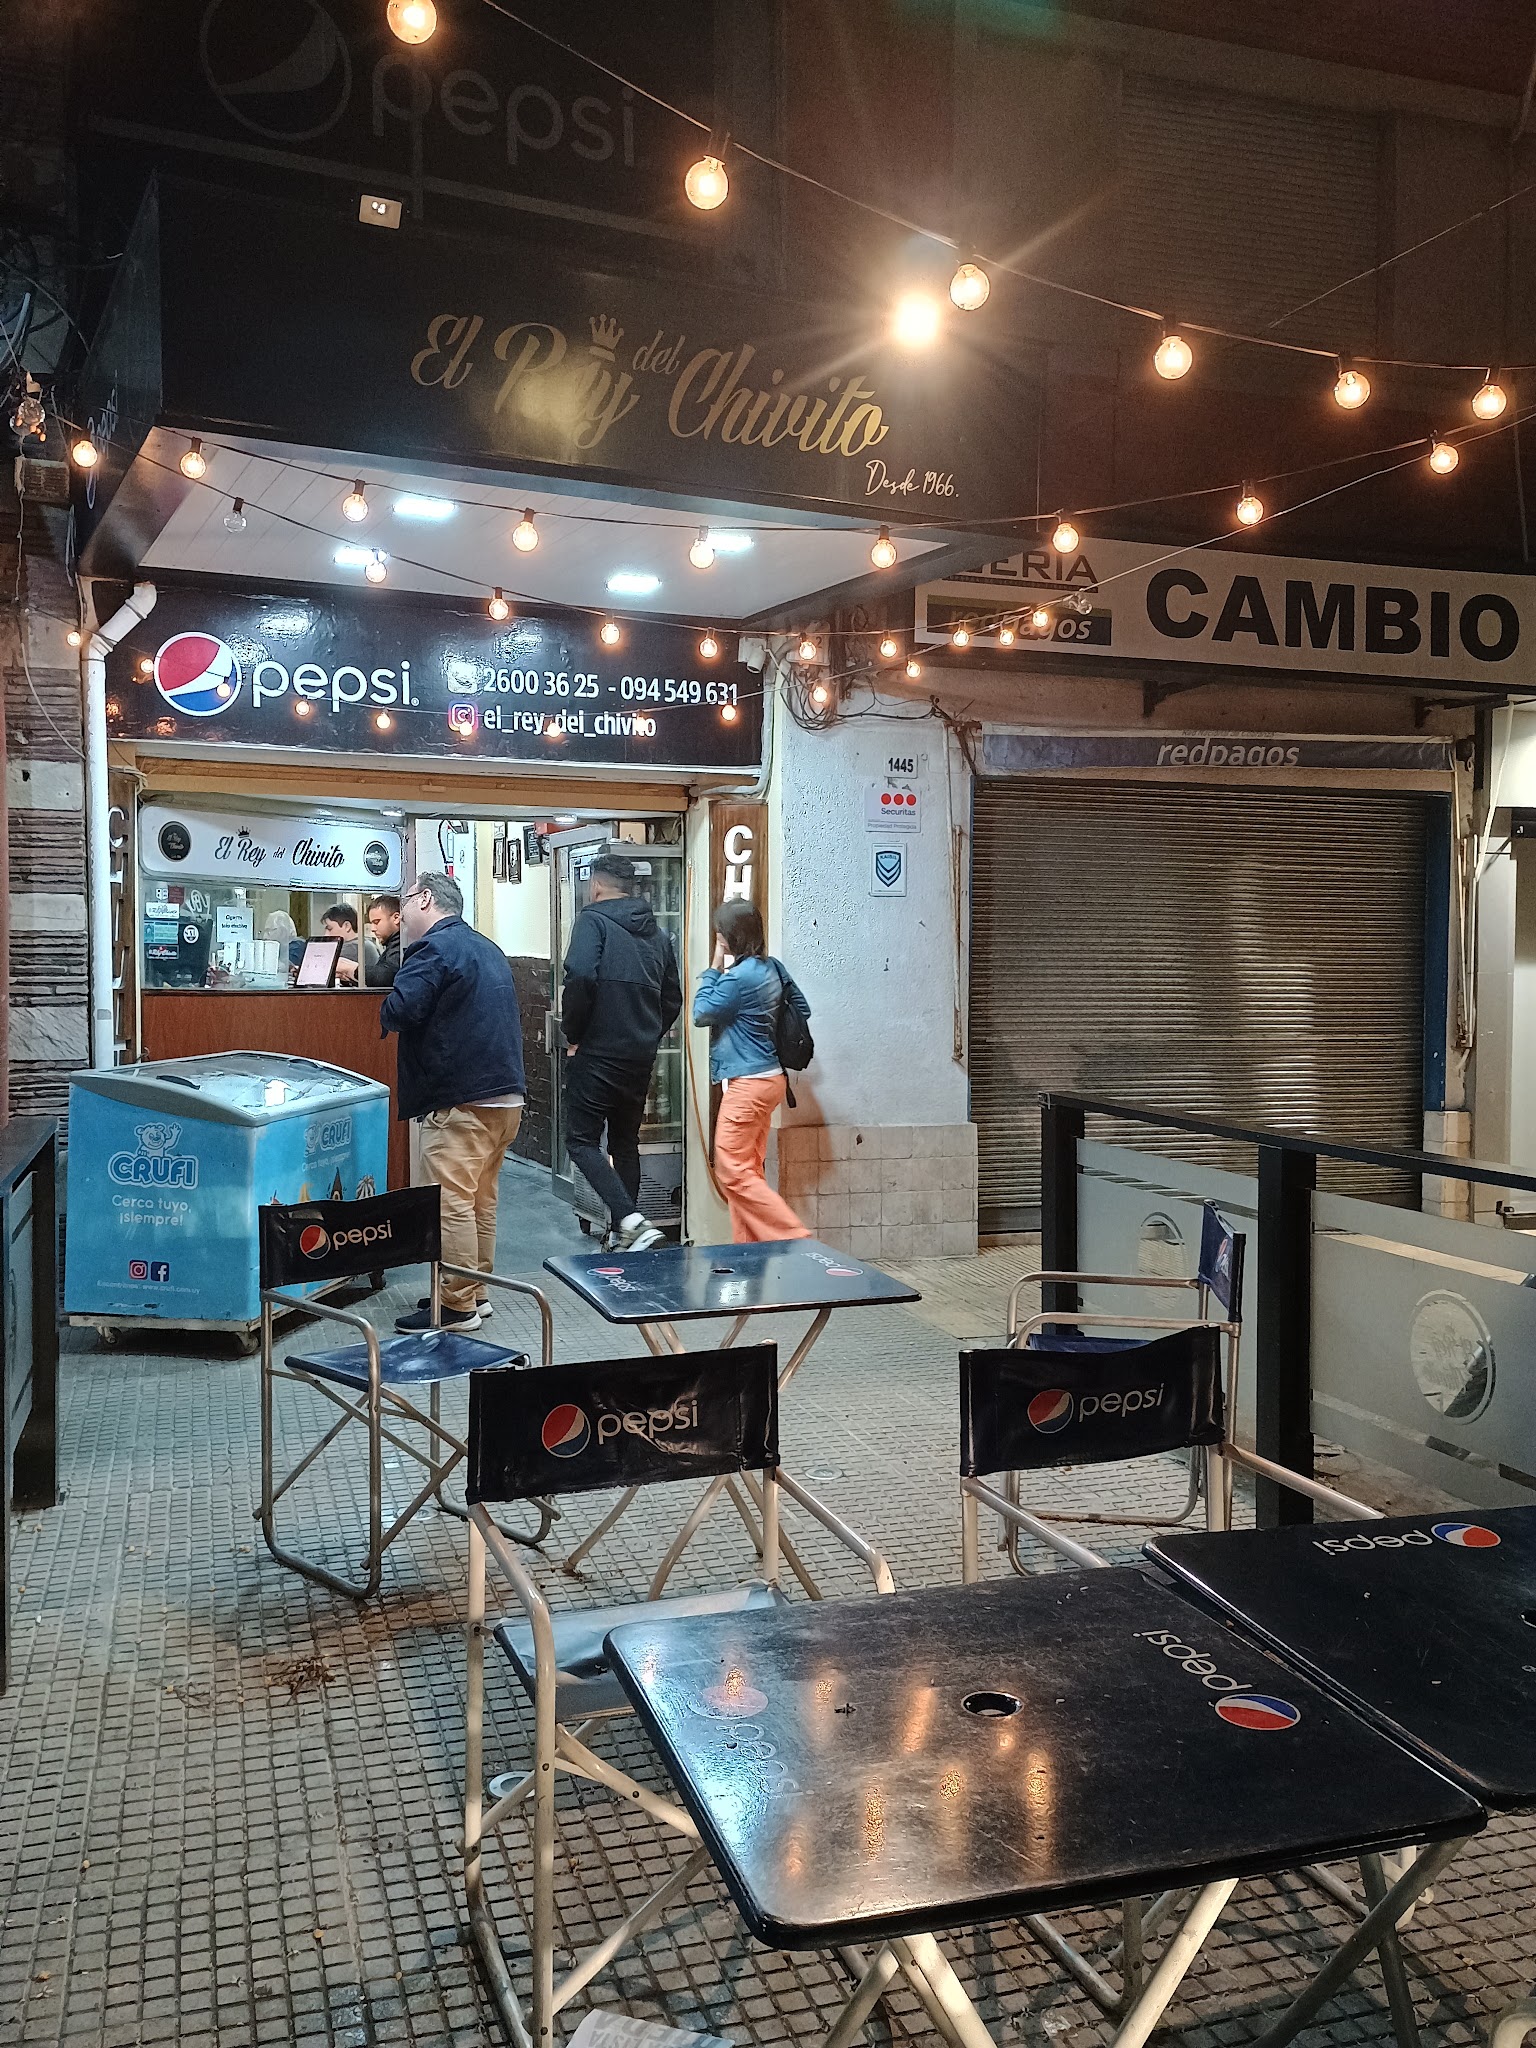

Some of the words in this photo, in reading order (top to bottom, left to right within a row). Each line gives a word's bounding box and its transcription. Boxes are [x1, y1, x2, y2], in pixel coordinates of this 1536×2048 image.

[372, 53, 635, 167] pepsi
[411, 314, 484, 390] El
[632, 330, 686, 375] del
[668, 343, 890, 457] Chivito
[865, 460, 919, 495] Desde
[1146, 568, 1520, 662] CAMBIO
[252, 660, 411, 713] pepsi
[483, 668, 540, 695] 2600
[543, 671, 570, 697] 36
[573, 673, 600, 698] 25
[620, 676, 661, 701] 094
[664, 679, 702, 705] 549
[705, 682, 739, 706] 631
[888, 757, 914, 773] 1445
[881, 807, 917, 816] Securitas
[214, 836, 234, 860] El
[236, 837, 267, 868] Rey
[292, 838, 346, 868] Chivito
[321, 1118, 351, 1149] CRUFI
[110, 1154, 196, 1187] CRUFI
[112, 1194, 154, 1209] Cerca
[158, 1197, 192, 1213] tuyo,
[333, 1219, 392, 1250] pepsi
[1078, 1382, 1165, 1423] pepsi
[597, 1399, 698, 1445] pepsi
[1312, 1529, 1434, 1556] pepsi
[1132, 1629, 1253, 1692] pepsi
